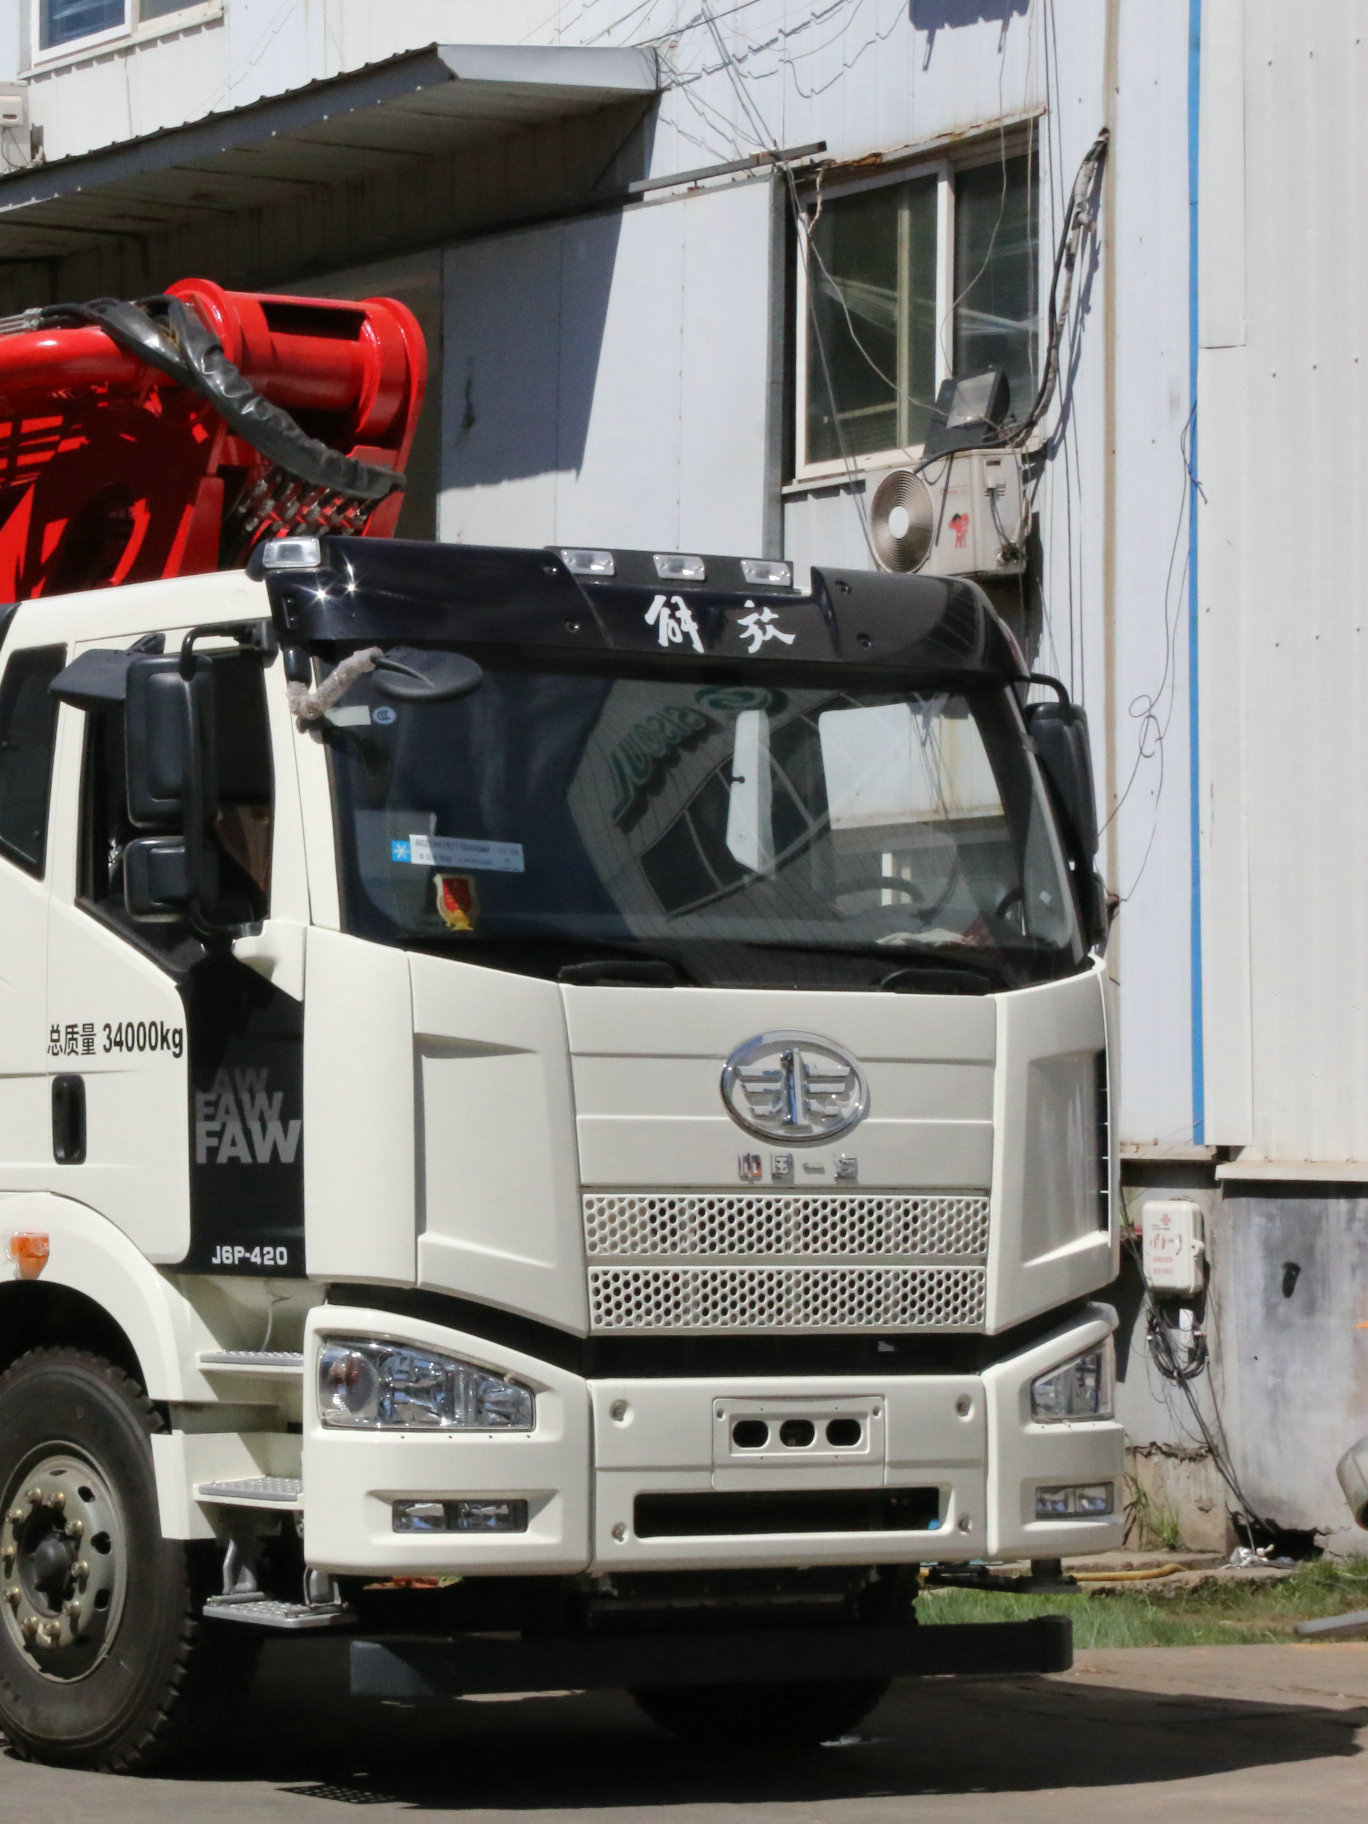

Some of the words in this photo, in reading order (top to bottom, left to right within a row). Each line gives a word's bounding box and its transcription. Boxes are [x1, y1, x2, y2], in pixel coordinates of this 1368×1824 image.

[47, 1022, 96, 1056] 总质量
[102, 1020, 183, 1058] 34000kg
[195, 1090, 284, 1121] FAW
[195, 1119, 303, 1164] FAW
[211, 1245, 288, 1266] J6P-420
